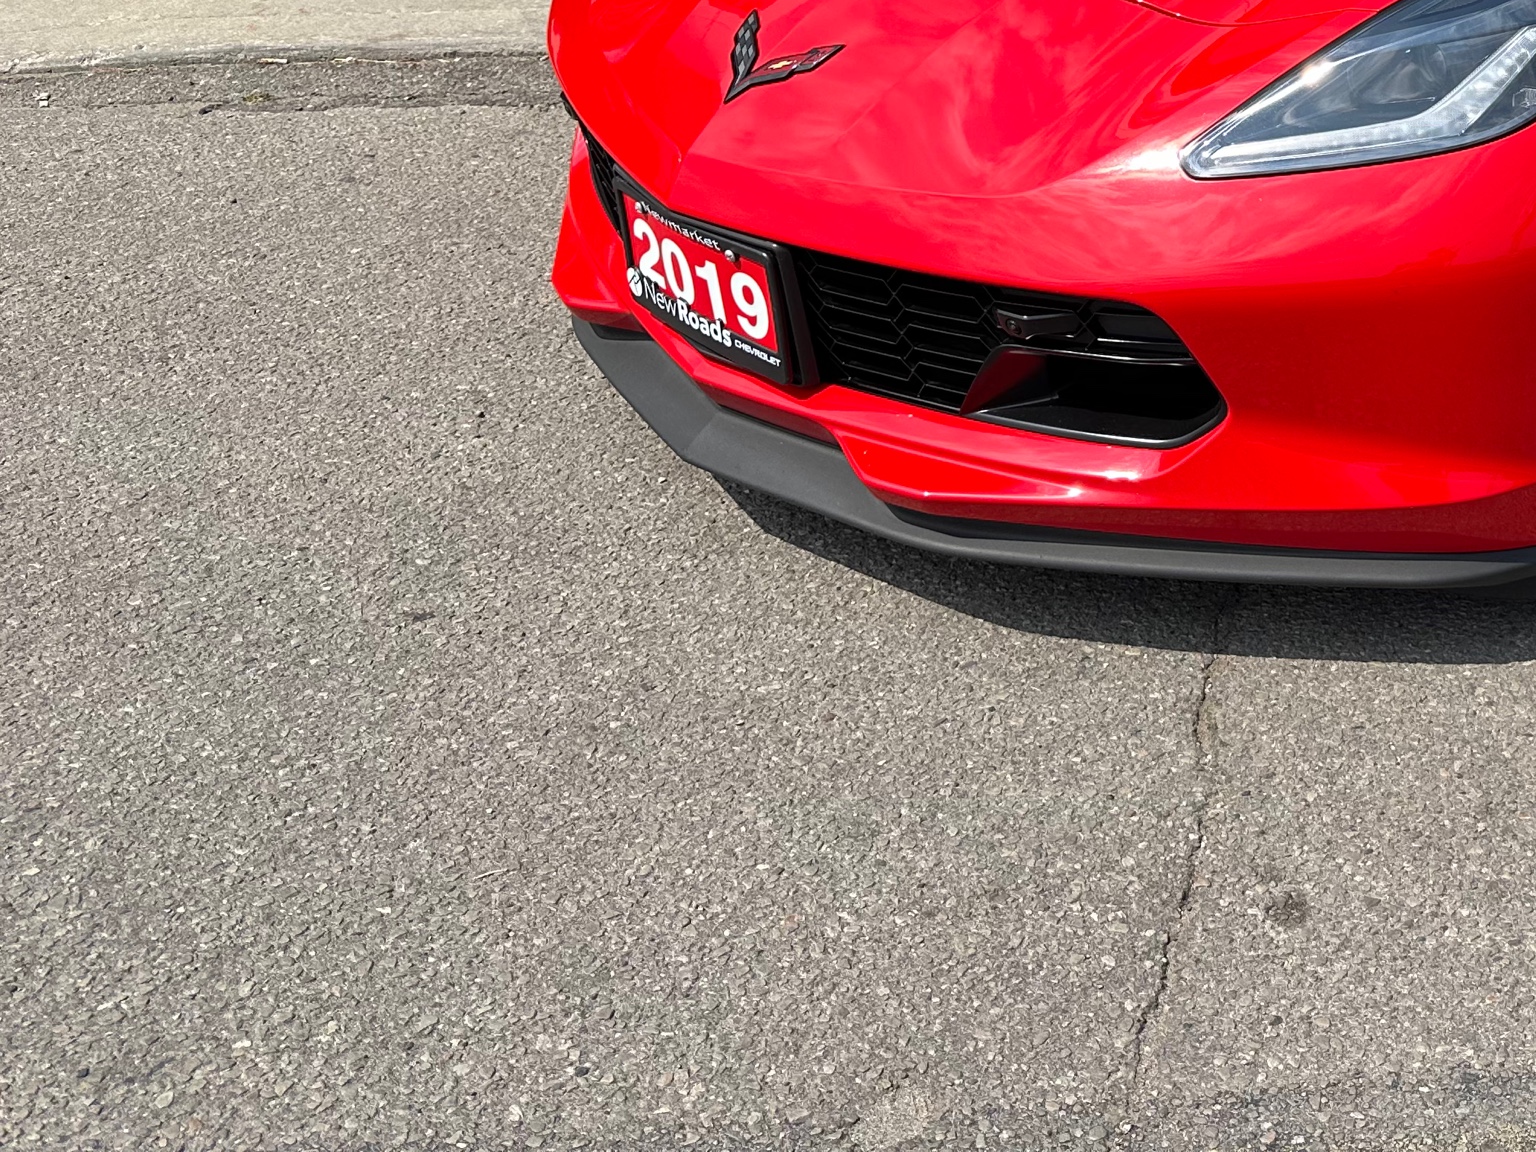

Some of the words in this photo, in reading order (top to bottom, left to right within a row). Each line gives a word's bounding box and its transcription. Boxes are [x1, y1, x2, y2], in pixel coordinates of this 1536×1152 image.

[641, 201, 720, 250] Newmarket
[633, 218, 770, 340] 2019
[643, 278, 732, 348] NewRoads
[734, 339, 781, 367] CHEVROLET
